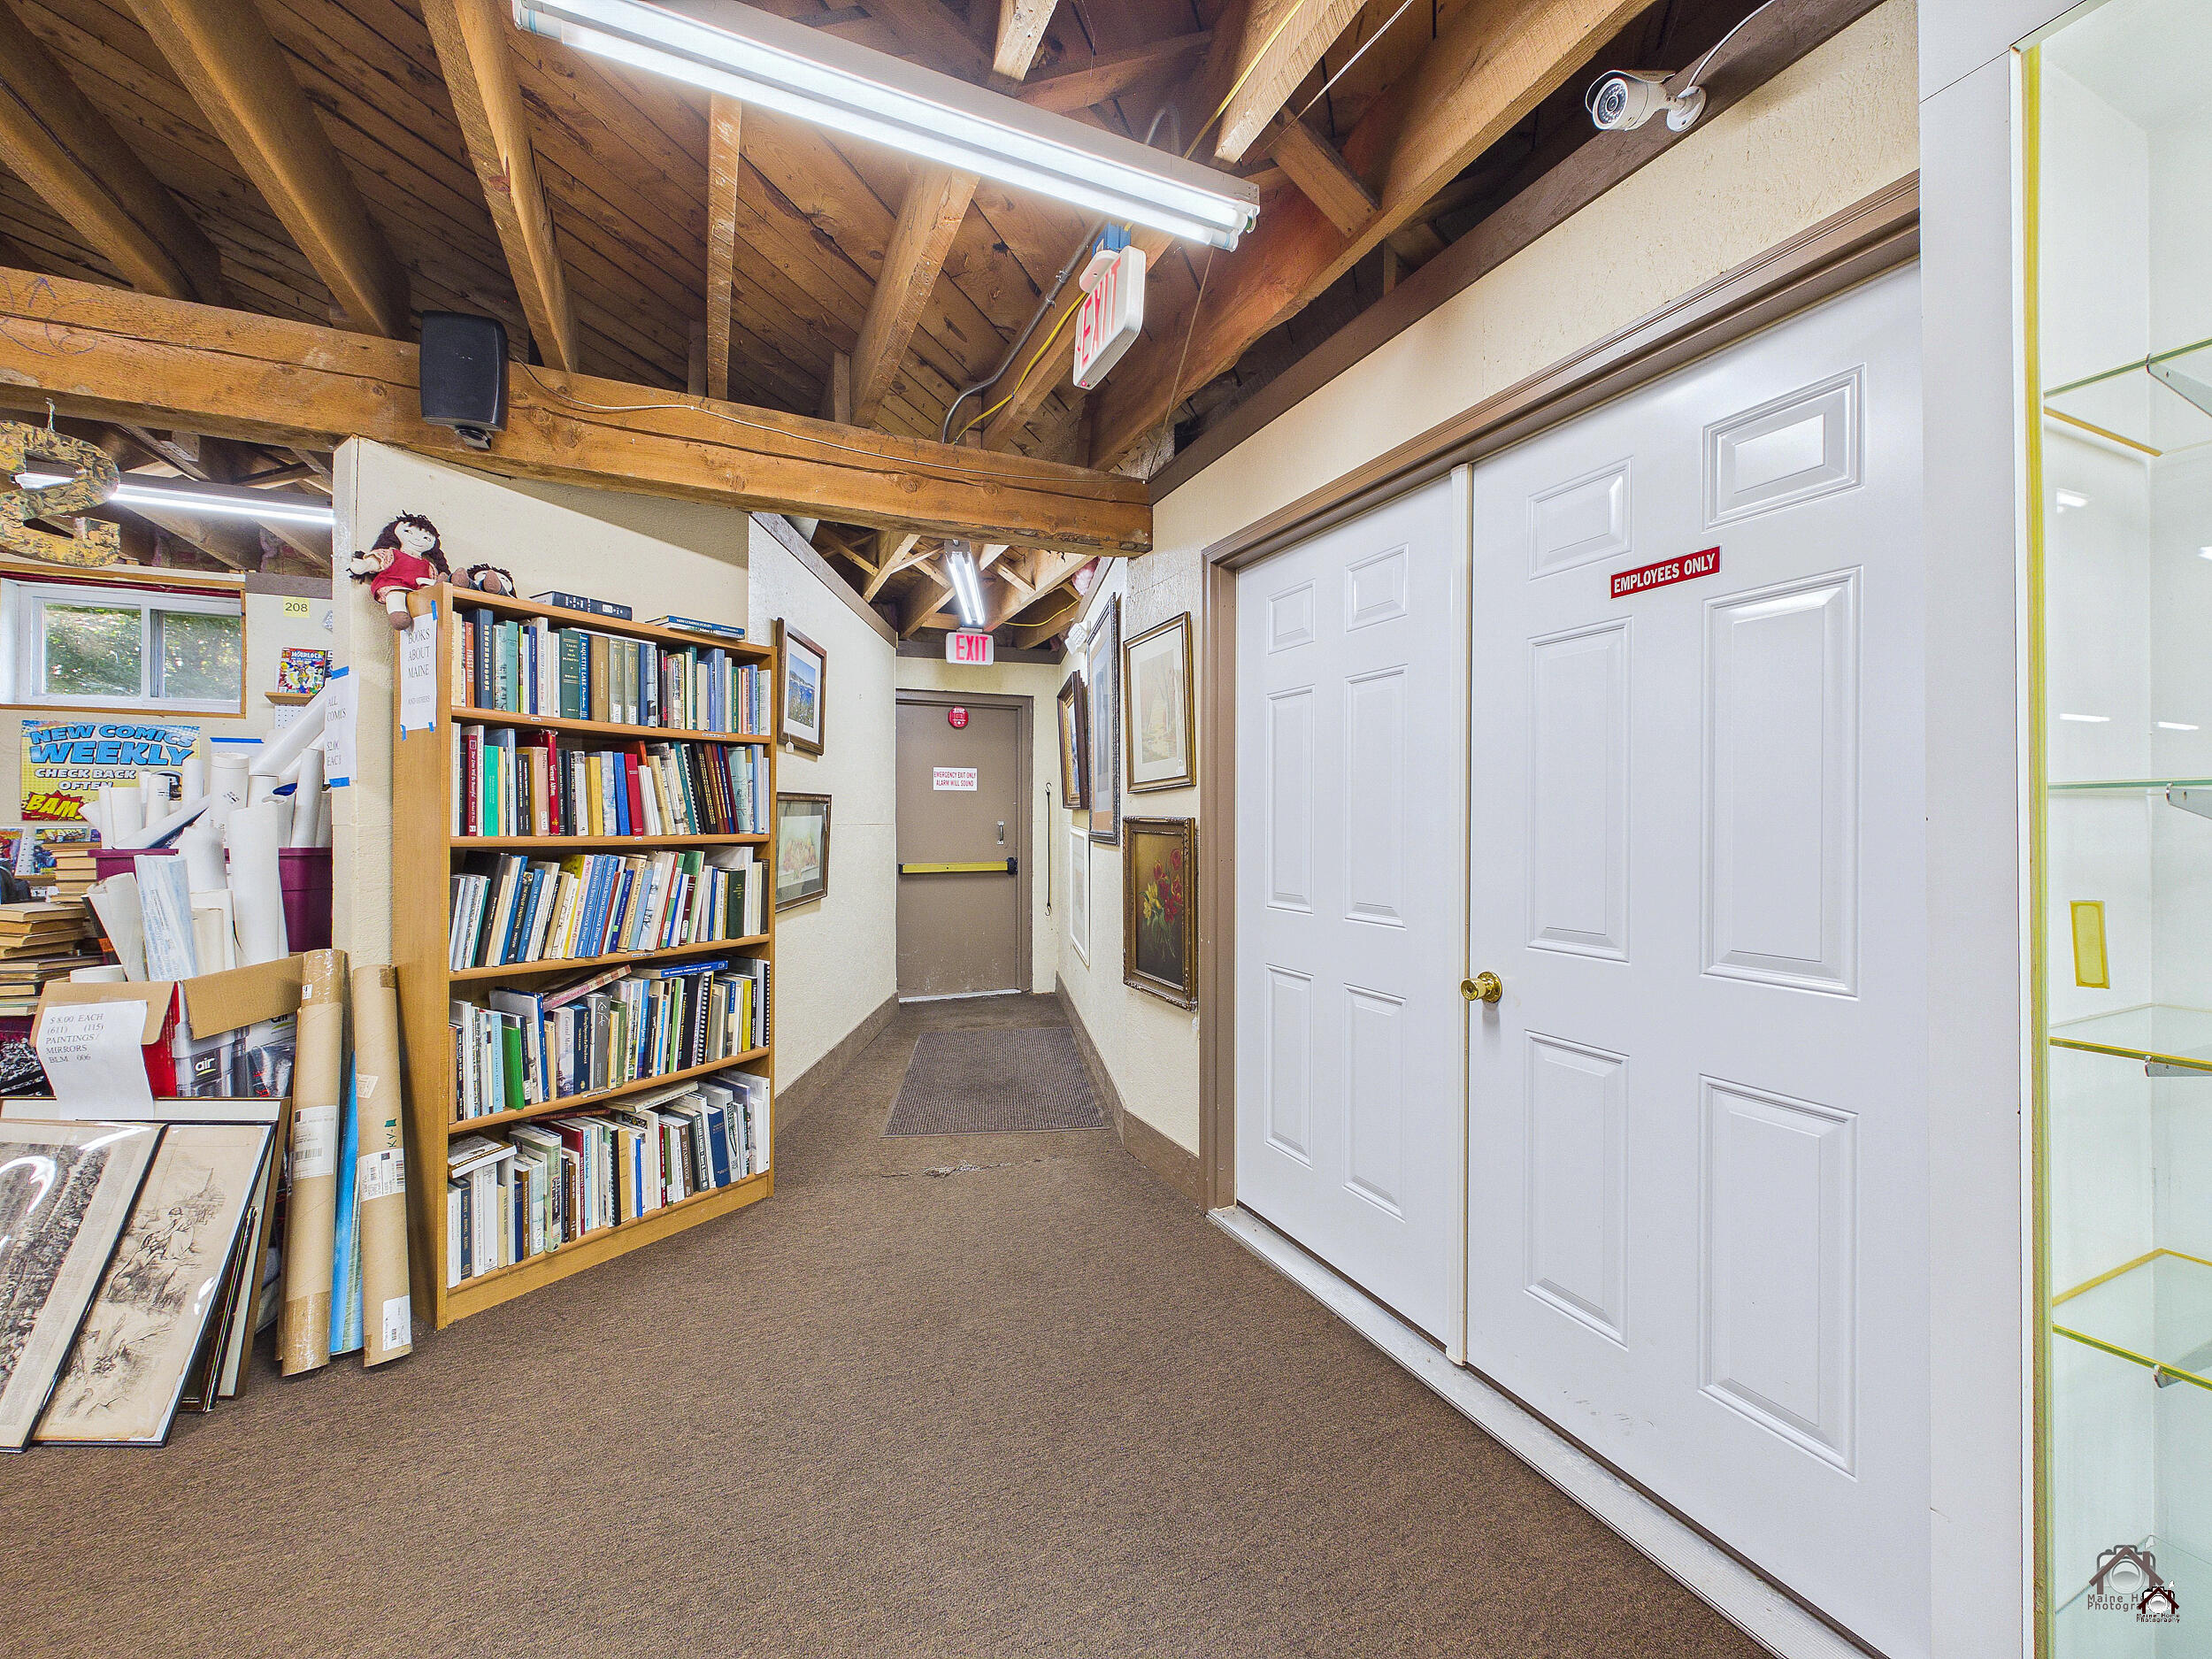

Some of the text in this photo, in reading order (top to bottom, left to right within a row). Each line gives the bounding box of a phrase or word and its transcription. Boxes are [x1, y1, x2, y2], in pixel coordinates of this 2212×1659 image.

[1081, 256, 1122, 370] EXIT
[1614, 552, 1715, 594] EMPLOYEES ONLY
[285, 603, 308, 612] 208
[408, 627, 430, 644] BOOKS
[408, 646, 430, 662] ABOUT
[956, 634, 988, 662] EXIT
[408, 664, 430, 679] MAINE
[328, 695, 339, 707] ALL
[31, 725, 196, 748] NEW COMICS
[29, 741, 195, 766] WEEKLY
[35, 768, 136, 780] CHECK BACK
[58, 781, 113, 790] OFTEN
[583, 906, 593, 926] HANCOCK
[78, 1013, 104, 1022] EACH
[46, 1045, 88, 1055] MIRRORS
[195, 1057, 216, 1071] air
